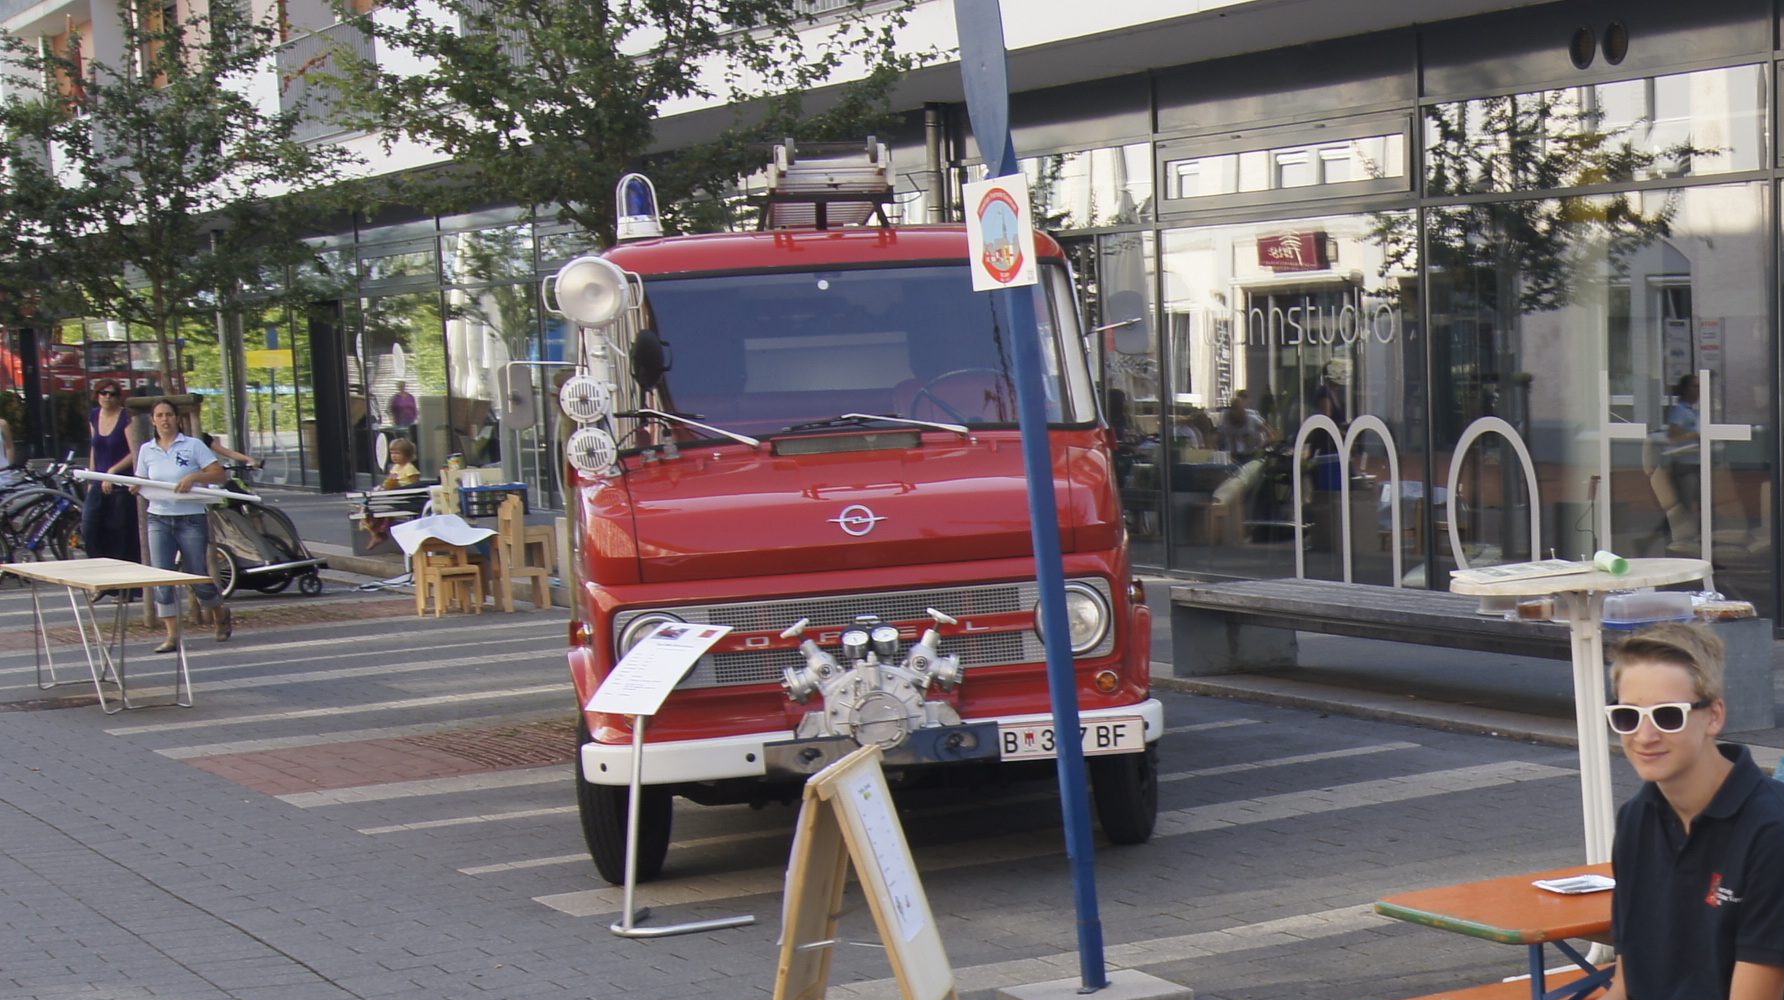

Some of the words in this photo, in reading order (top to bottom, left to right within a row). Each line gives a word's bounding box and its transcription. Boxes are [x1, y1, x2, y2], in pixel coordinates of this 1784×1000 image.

[1004, 731, 1018, 754] B
[1042, 727, 1088, 751] 37
[1097, 724, 1126, 748] BF
